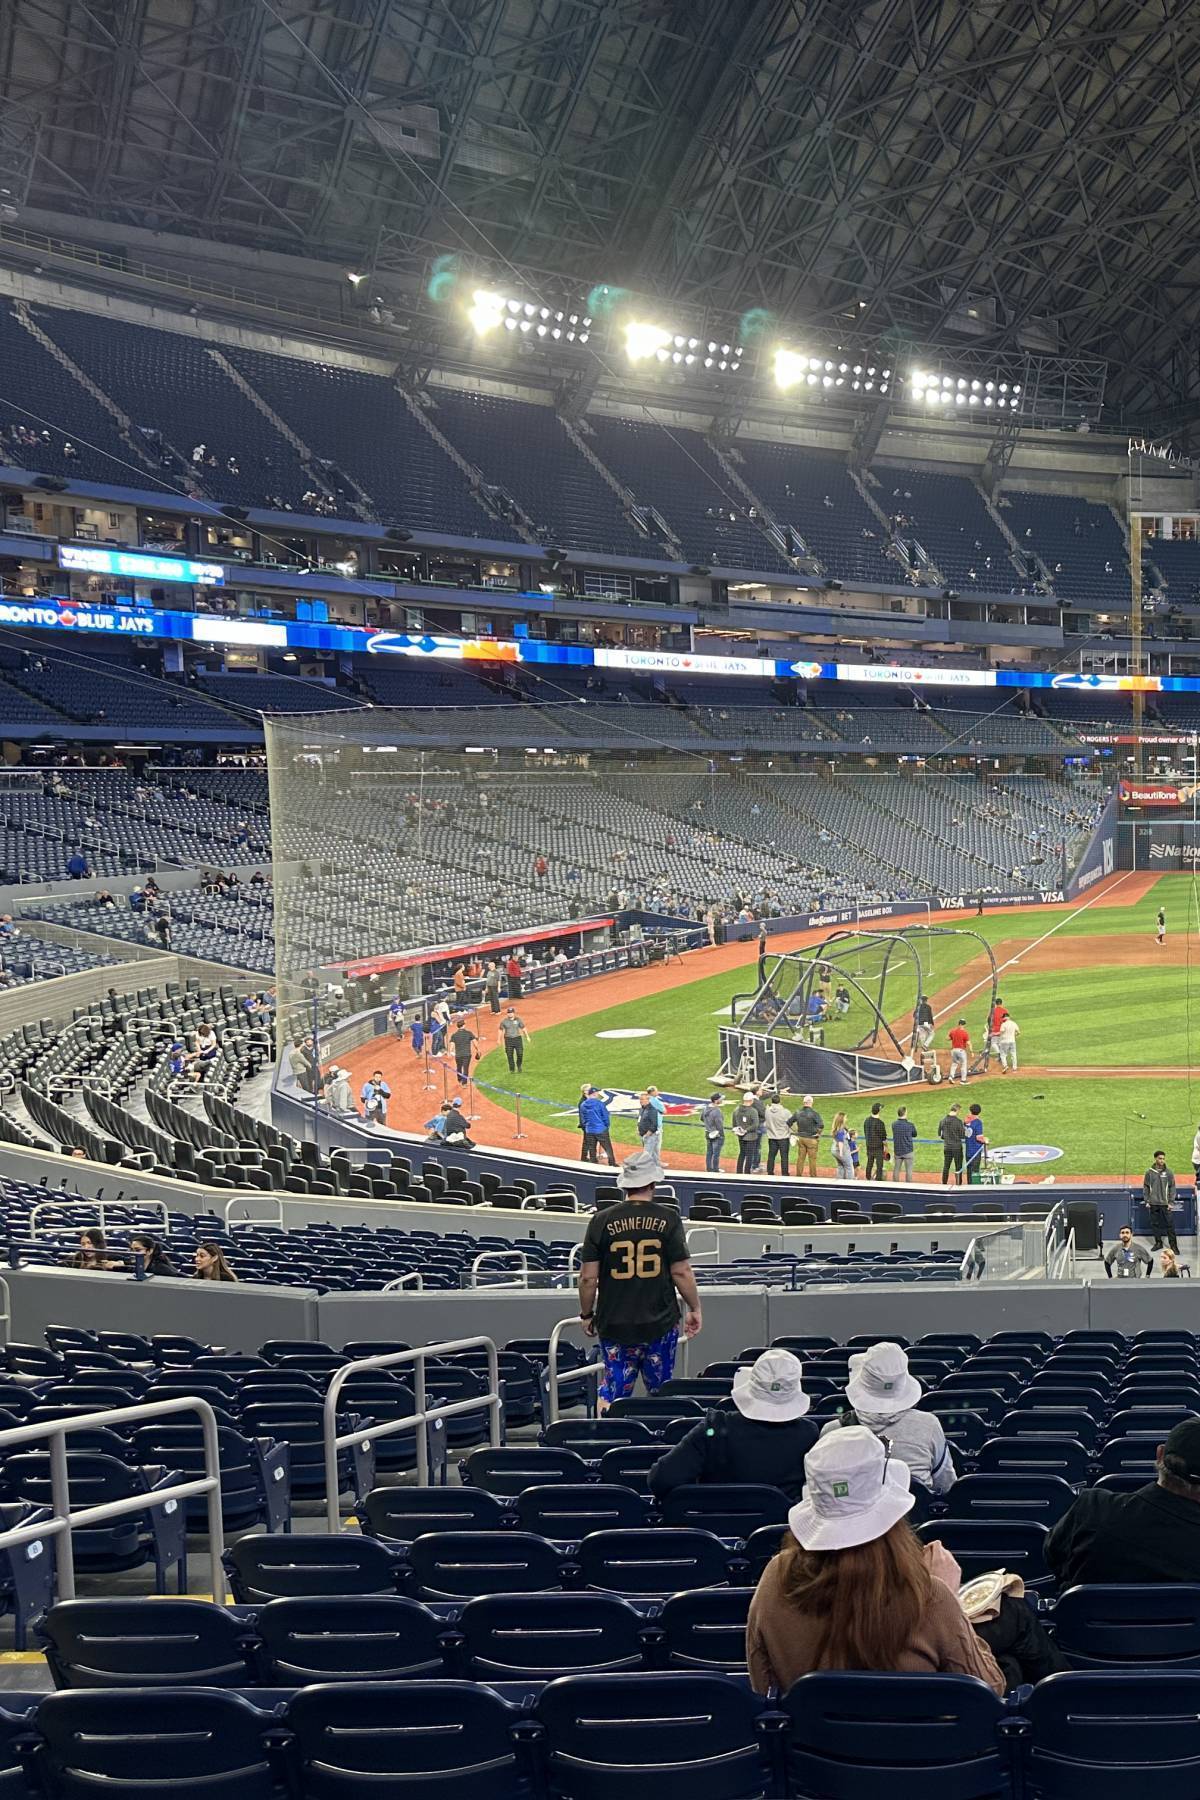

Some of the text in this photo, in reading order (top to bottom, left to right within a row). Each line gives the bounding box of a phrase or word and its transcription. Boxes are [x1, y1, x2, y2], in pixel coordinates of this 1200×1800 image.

[77, 612, 114, 630] BLUE
[117, 616, 154, 632] JAYS
[624, 654, 680, 667] TORONTO
[863, 669, 912, 679] TORONTO
[1131, 791, 1177, 800] BeautiTone
[938, 896, 965, 908] VISA
[1040, 891, 1065, 903] VISA
[808, 915, 838, 926] theScore
[841, 912, 852, 920] BET
[882, 906, 893, 914] BOX
[606, 1216, 667, 1236] SCHNEIDER
[610, 1239, 662, 1280] 36
